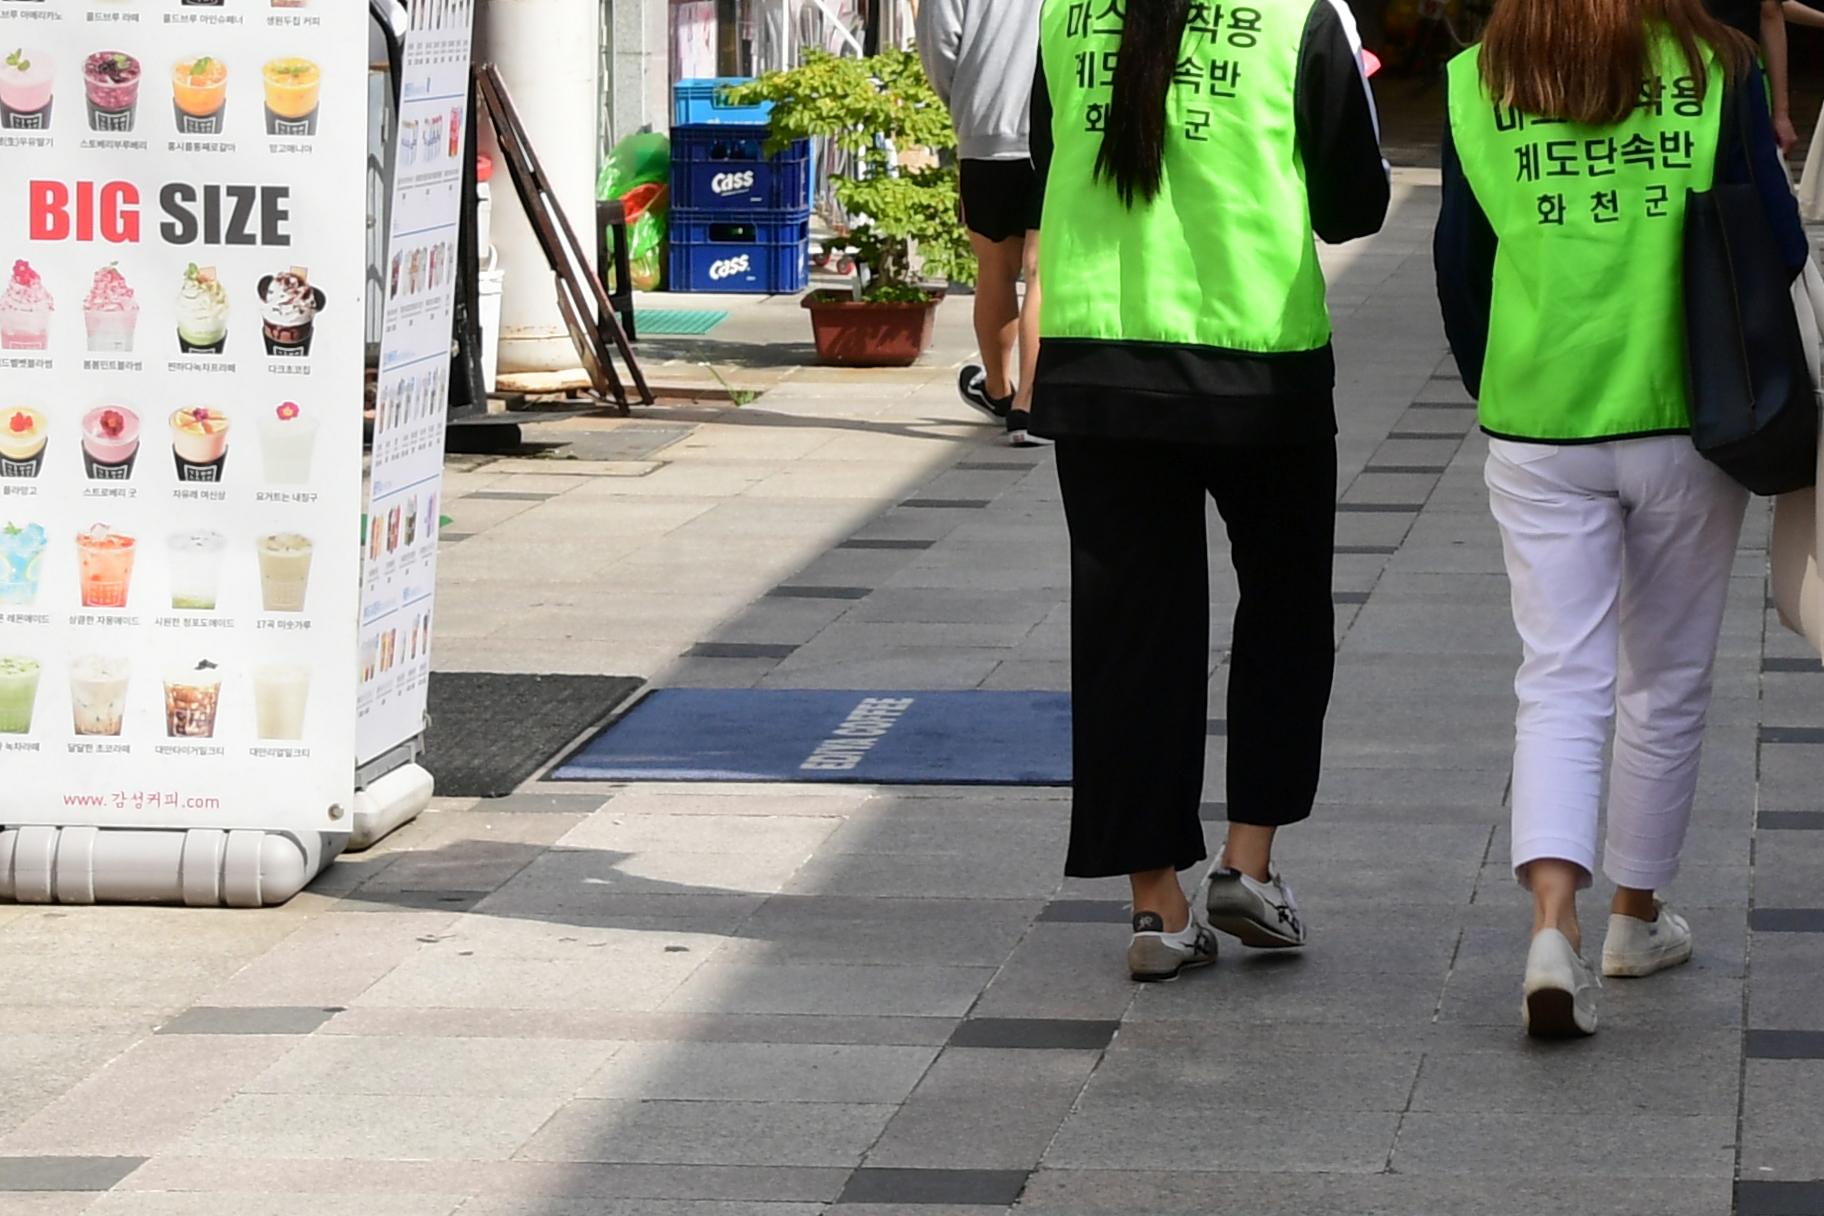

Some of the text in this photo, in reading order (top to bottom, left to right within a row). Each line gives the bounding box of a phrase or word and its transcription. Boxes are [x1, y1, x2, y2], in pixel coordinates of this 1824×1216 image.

[1185, 3, 1263, 49] 착용
[1514, 131, 1695, 182] 계도단속반
[711, 170, 754, 193] Cass
[29, 179, 291, 247] BIG SIZE
[709, 254, 749, 280] Cass
